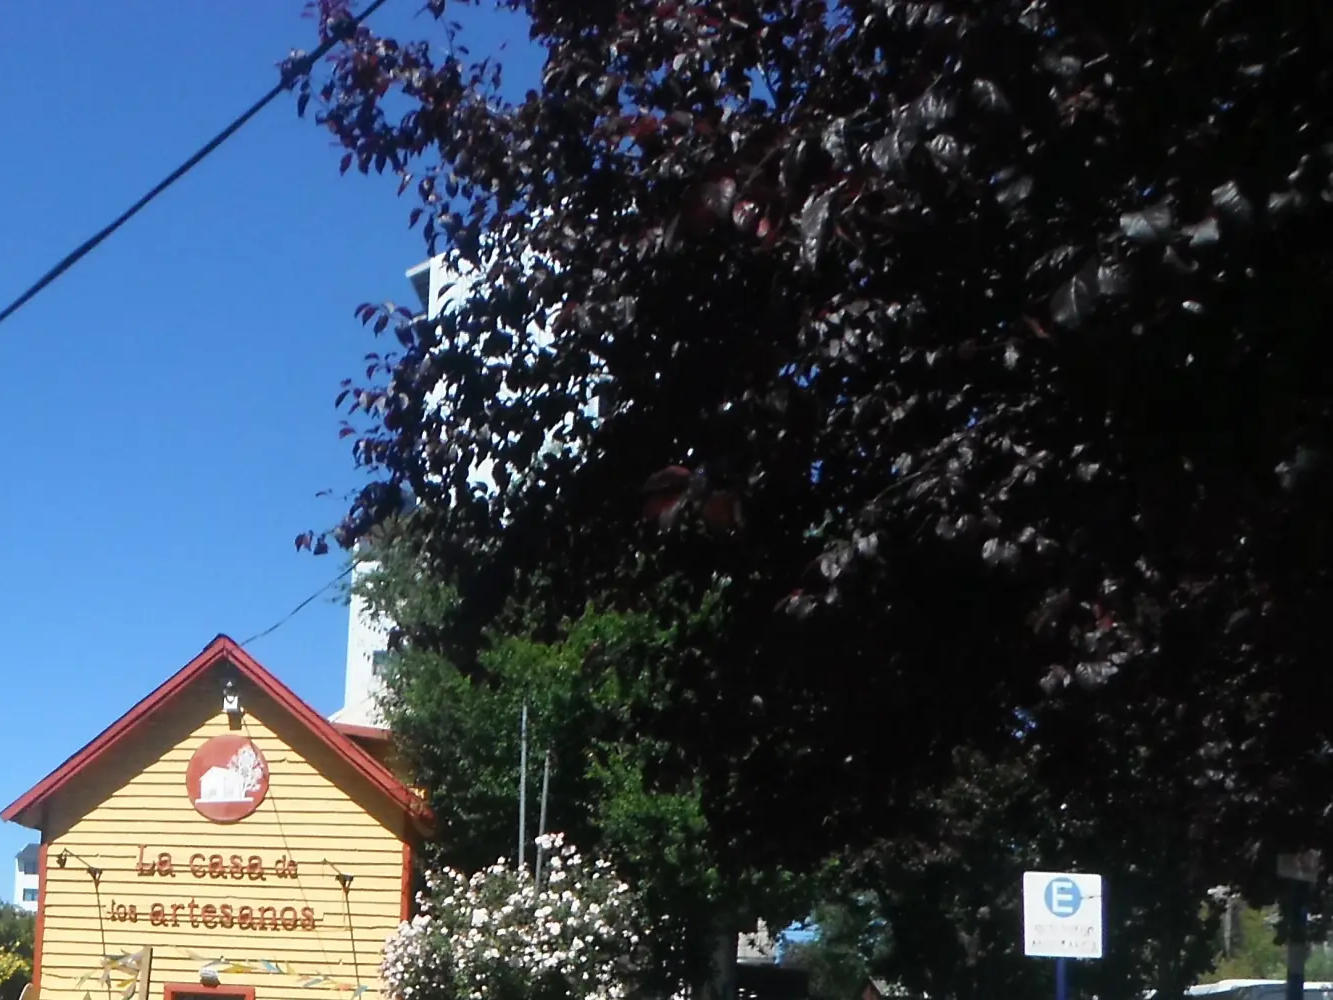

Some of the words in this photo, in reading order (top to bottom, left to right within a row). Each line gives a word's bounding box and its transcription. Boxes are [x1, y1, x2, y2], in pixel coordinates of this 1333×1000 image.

[137, 844, 175, 878] La
[189, 853, 267, 881] casa
[275, 855, 299, 880] de
[107, 899, 138, 923] los
[149, 896, 316, 932] artesanos
[1052, 881, 1073, 913] E
